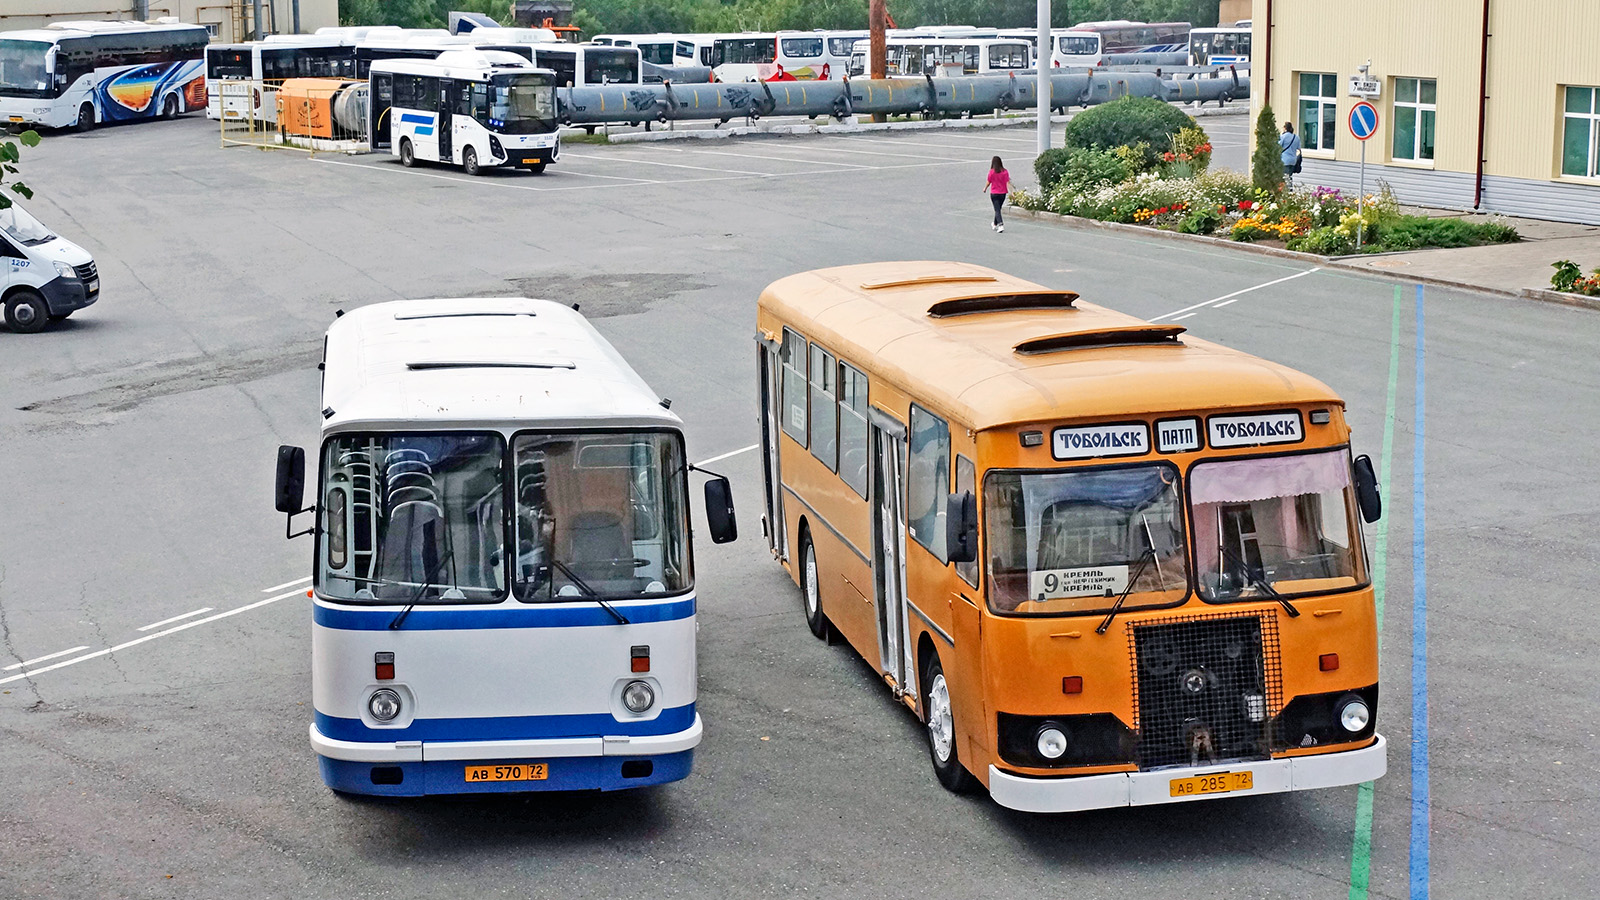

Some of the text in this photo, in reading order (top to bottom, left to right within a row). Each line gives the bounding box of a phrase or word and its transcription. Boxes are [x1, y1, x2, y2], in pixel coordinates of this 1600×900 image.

[11, 259, 31, 268] 1207
[1162, 428, 1194, 446] ПАТП
[1215, 420, 1296, 439] ТОБОЛЬСК
[1059, 431, 1142, 449] ТОБОЛЬСК
[1044, 573, 1059, 594] 9
[1063, 570, 1104, 579] КРЕМЛЬ
[1063, 584, 1103, 593] КРЕМЛЬ
[495, 766, 521, 779] 570
[529, 765, 543, 775] 72
[1200, 776, 1226, 791] 285
[1234, 773, 1248, 784] 72
